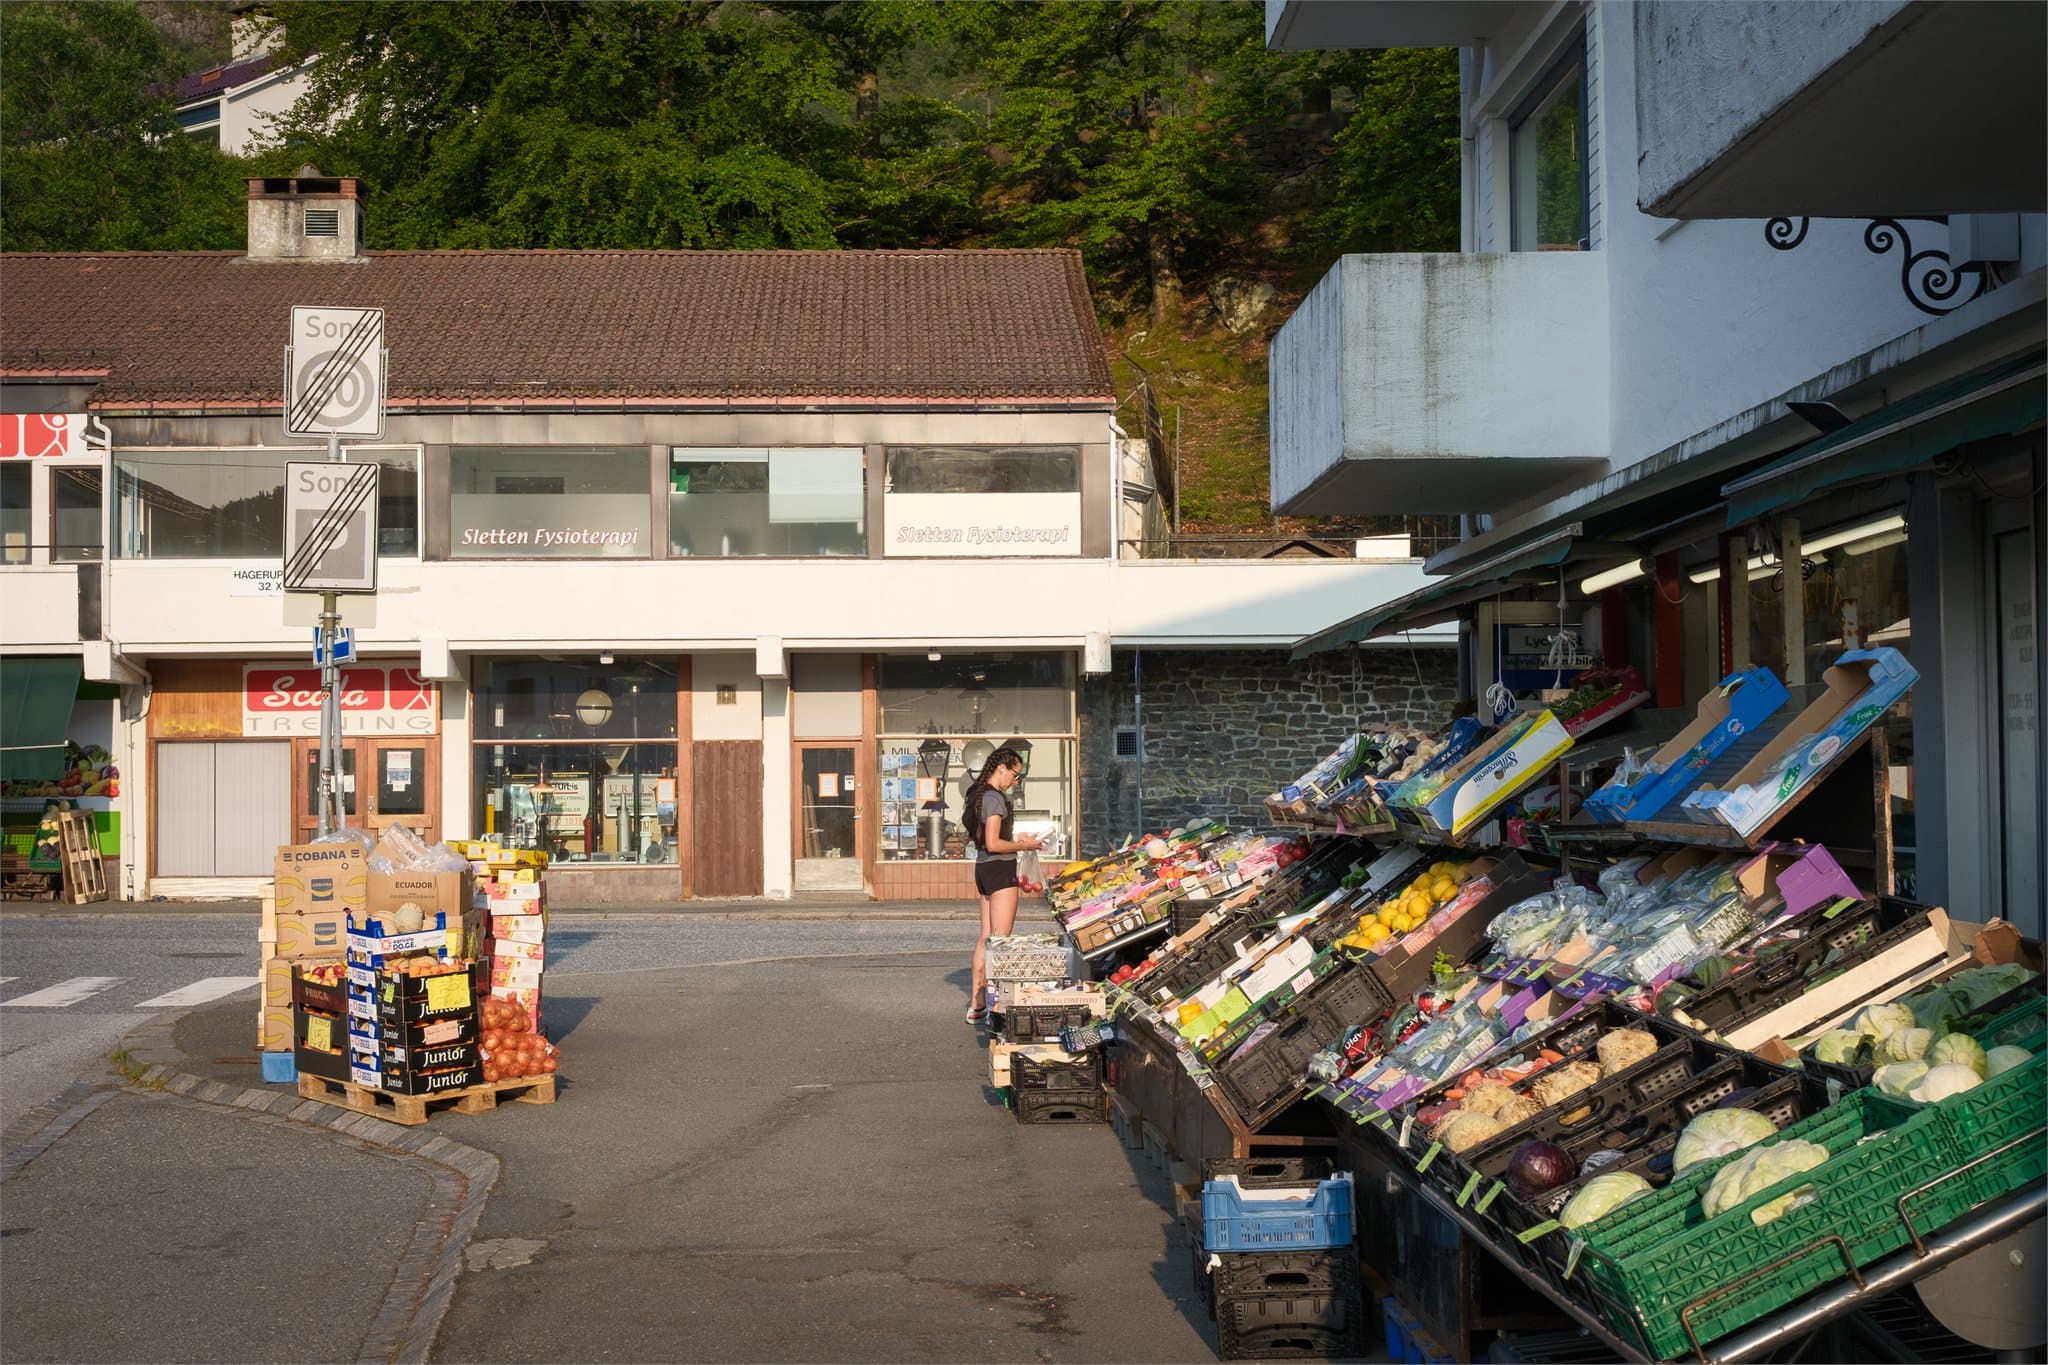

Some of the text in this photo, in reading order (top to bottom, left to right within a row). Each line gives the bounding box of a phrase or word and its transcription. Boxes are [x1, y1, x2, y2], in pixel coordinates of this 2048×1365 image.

[299, 470, 364, 494] Sone
[312, 518, 349, 571] P
[461, 527, 639, 547] Sletten Fysioterapi
[897, 525, 1069, 545] Sletten Fysioterapi
[258, 582, 271, 591] 32
[247, 715, 433, 732] TREING
[609, 783, 656, 793] URIS
[295, 849, 347, 863] COBANA
[395, 881, 433, 890] ECUADOR
[423, 1047, 467, 1068] Junior
[426, 1071, 470, 1092] Junior
